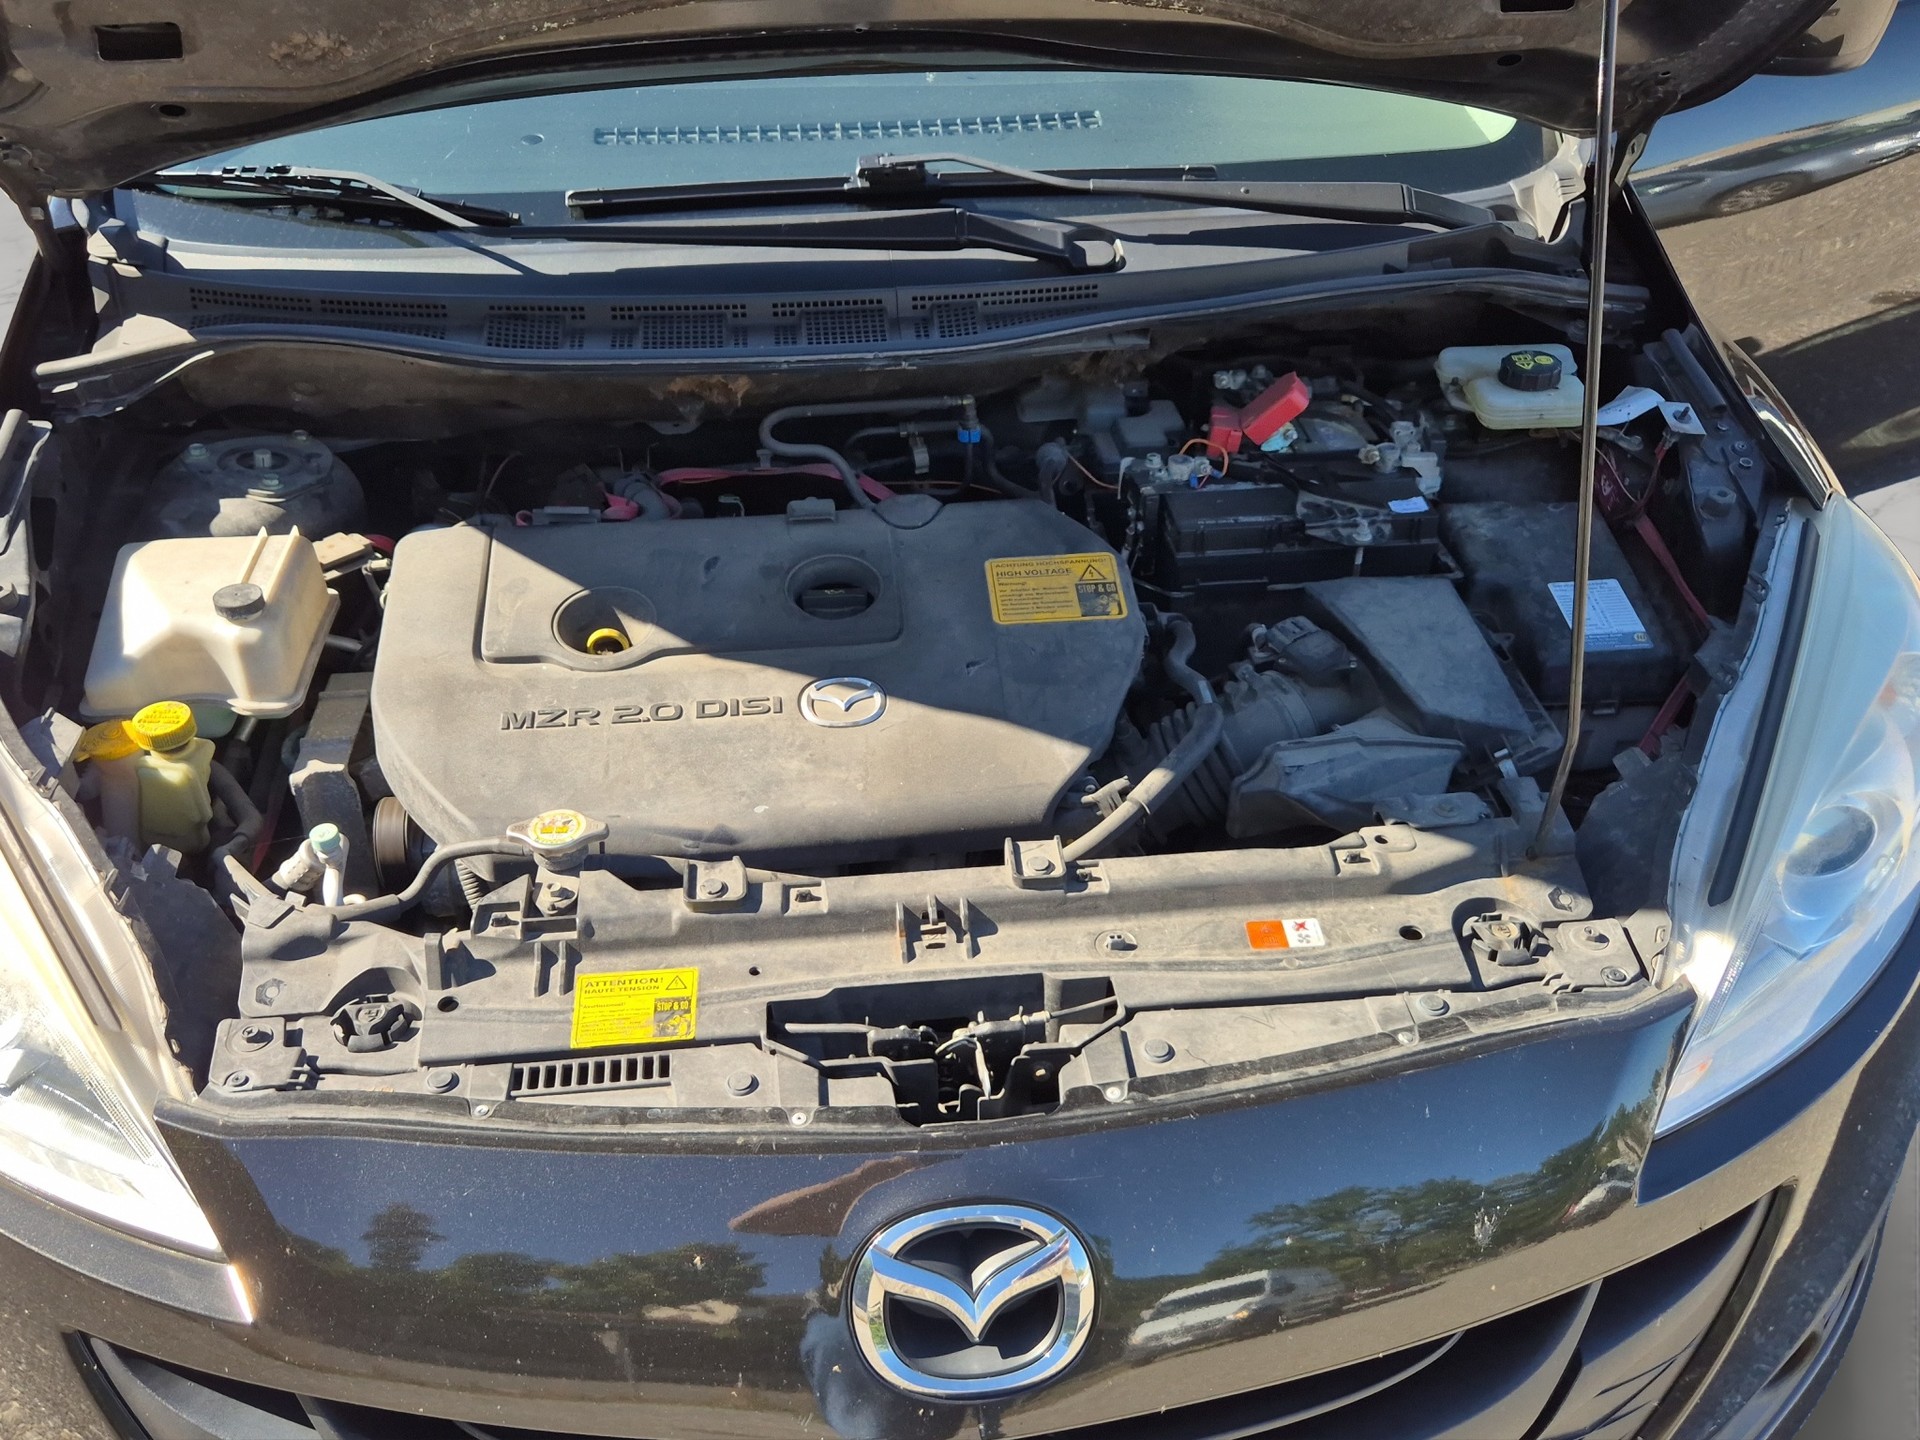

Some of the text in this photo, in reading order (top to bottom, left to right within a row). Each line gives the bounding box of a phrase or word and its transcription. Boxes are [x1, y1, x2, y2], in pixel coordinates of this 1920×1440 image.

[1026, 567, 1073, 576] VOLTAGE
[1077, 584, 1096, 593] STOP
[1098, 583, 1105, 592] &
[1106, 583, 1116, 592] GO
[500, 695, 784, 731] MZR 2.0 DISI
[585, 977, 664, 988] ATTENTION!
[618, 985, 660, 993] TENSION
[657, 1001, 672, 1011] STOP
[673, 1001, 679, 1010] &
[680, 1000, 689, 1010] GO
